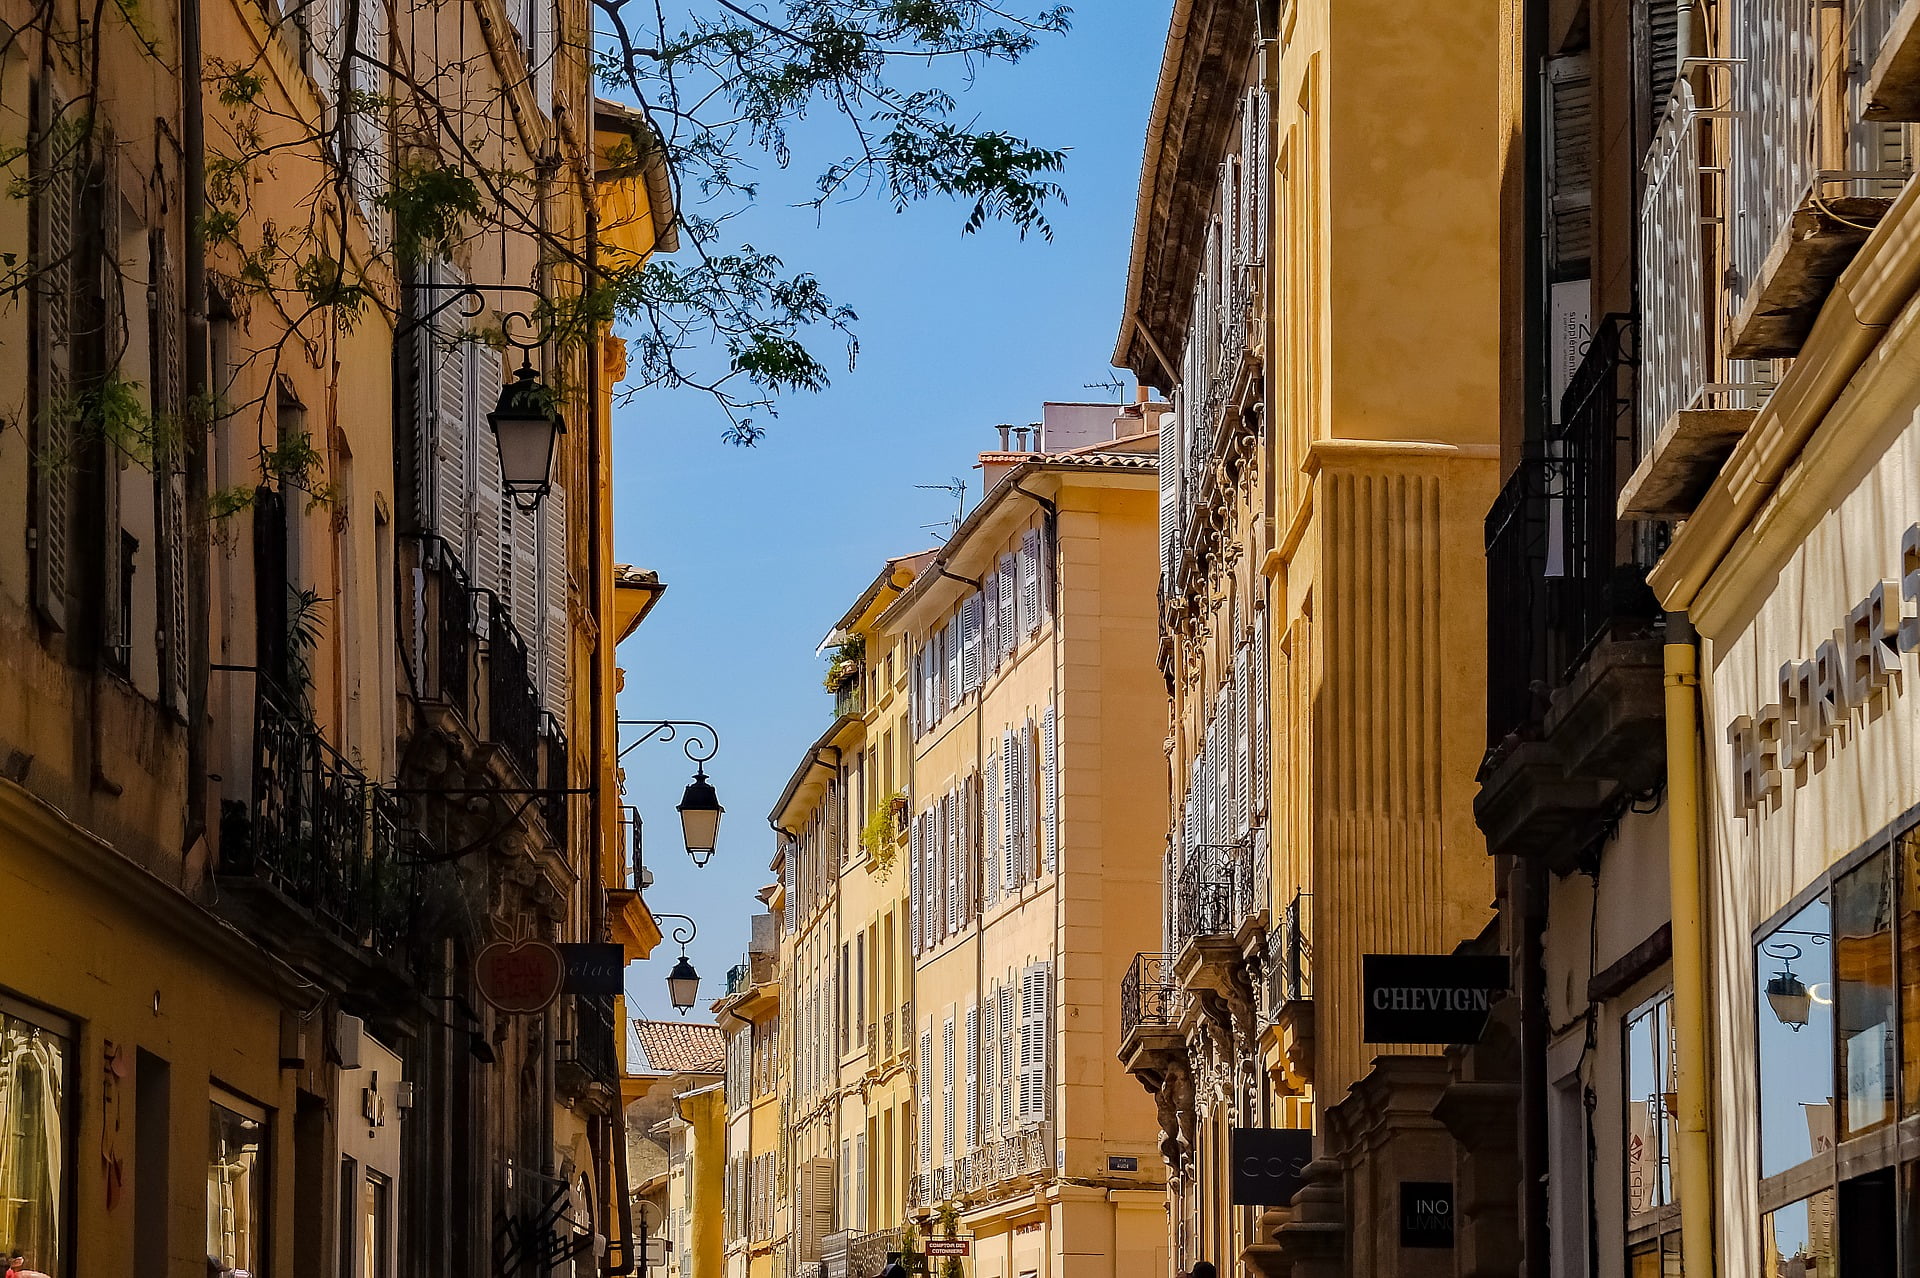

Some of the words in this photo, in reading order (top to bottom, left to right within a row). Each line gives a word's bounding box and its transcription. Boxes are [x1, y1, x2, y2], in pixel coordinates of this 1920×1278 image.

[1778, 578, 1902, 770] CORNER
[1373, 987, 1489, 1011] CHEVIGN
[1240, 1156, 1304, 1178] COS
[1416, 1199, 1449, 1215] INO
